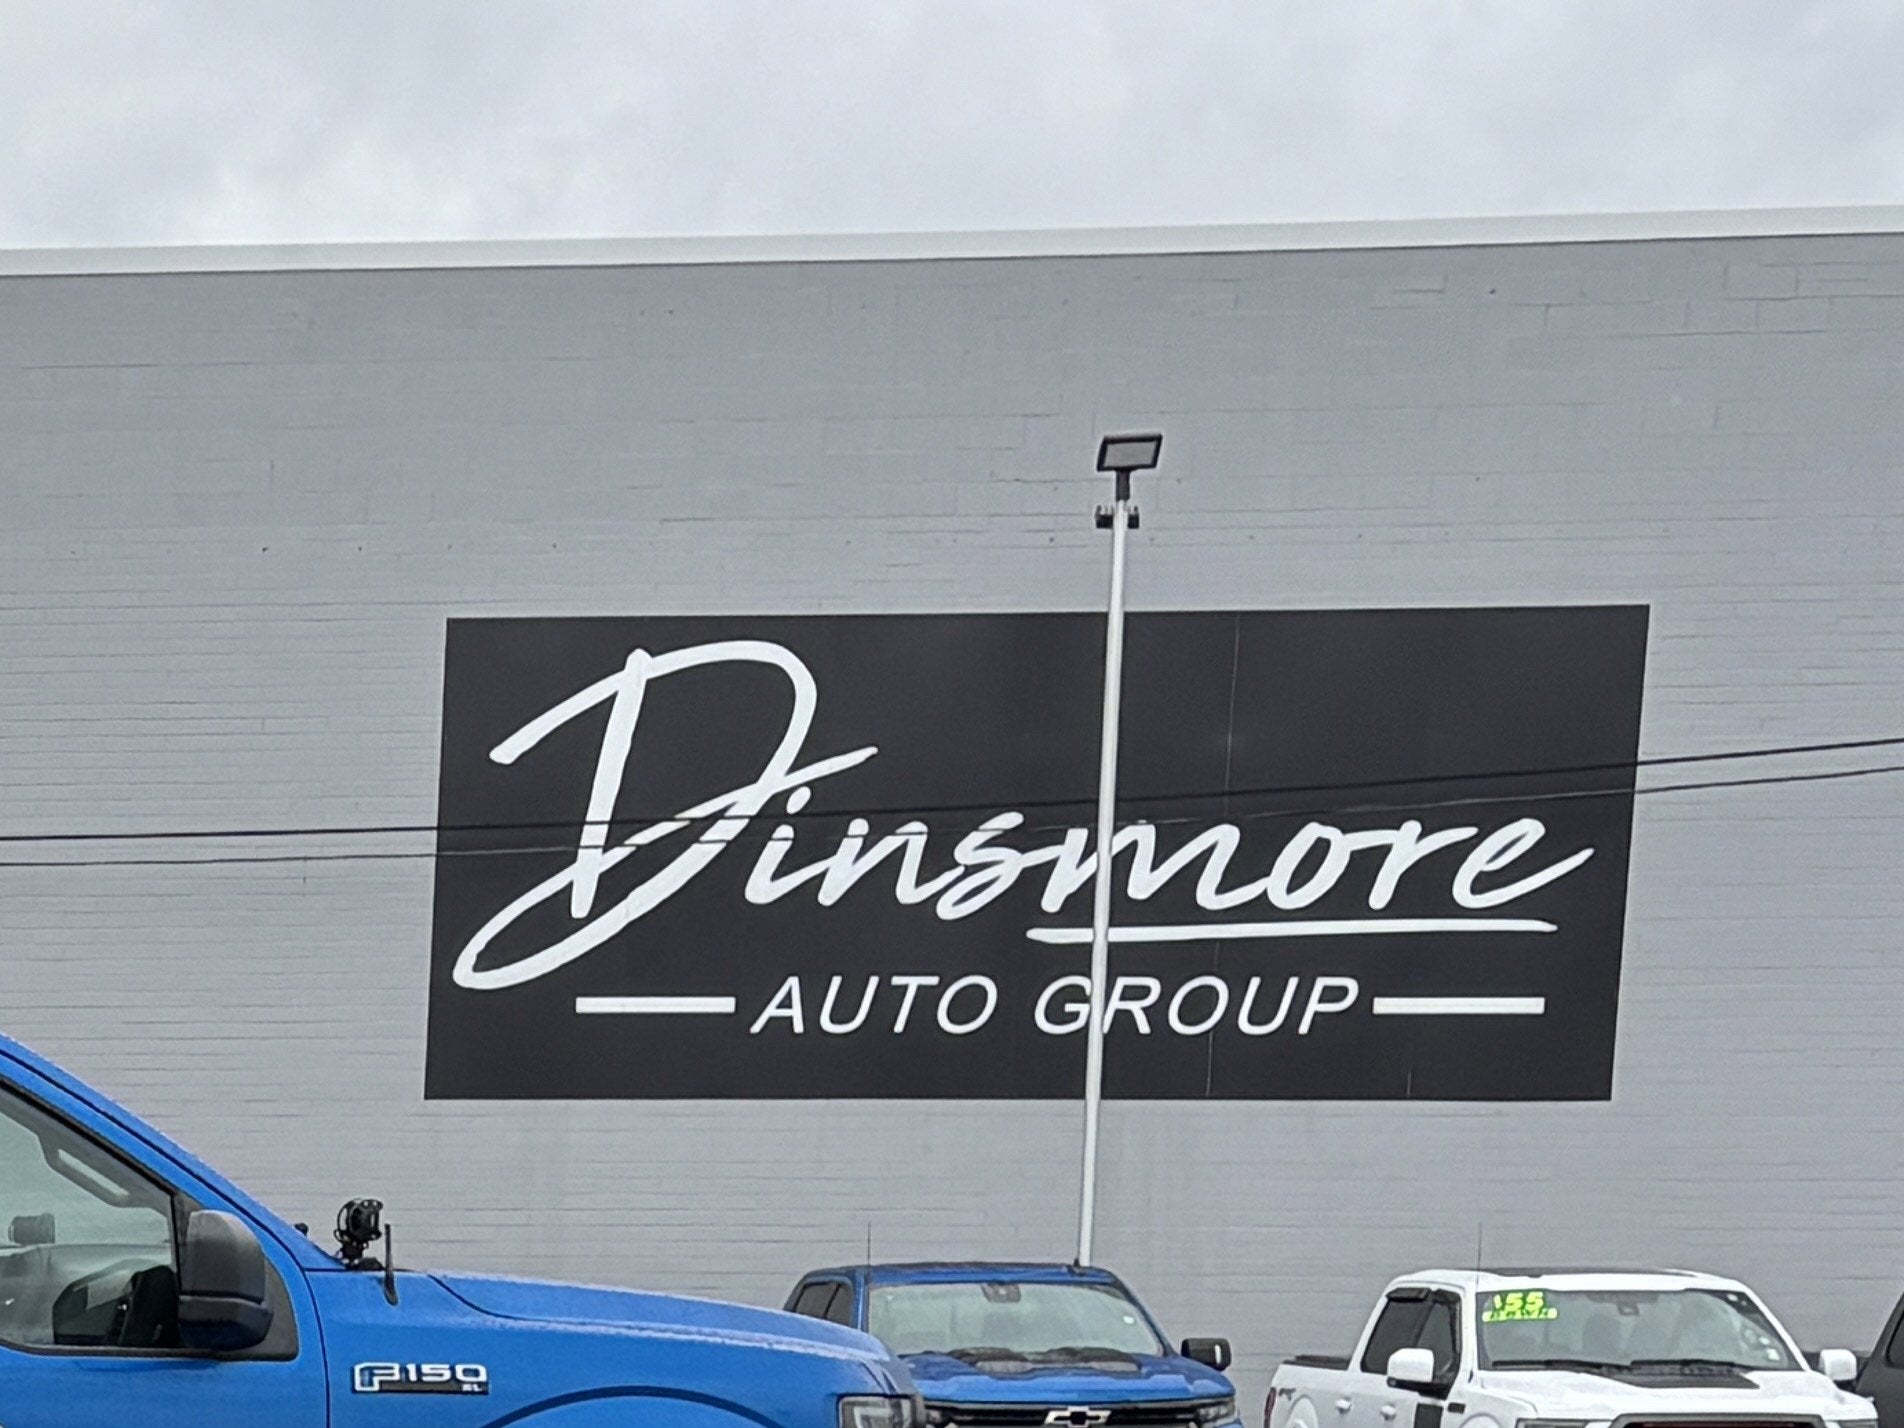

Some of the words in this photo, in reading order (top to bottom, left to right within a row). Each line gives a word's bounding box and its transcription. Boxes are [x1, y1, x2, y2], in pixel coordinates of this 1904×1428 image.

[453, 640, 1595, 990] Dinsmore
[749, 975, 998, 1035] AUTO
[1033, 974, 1360, 1035] GROUP
